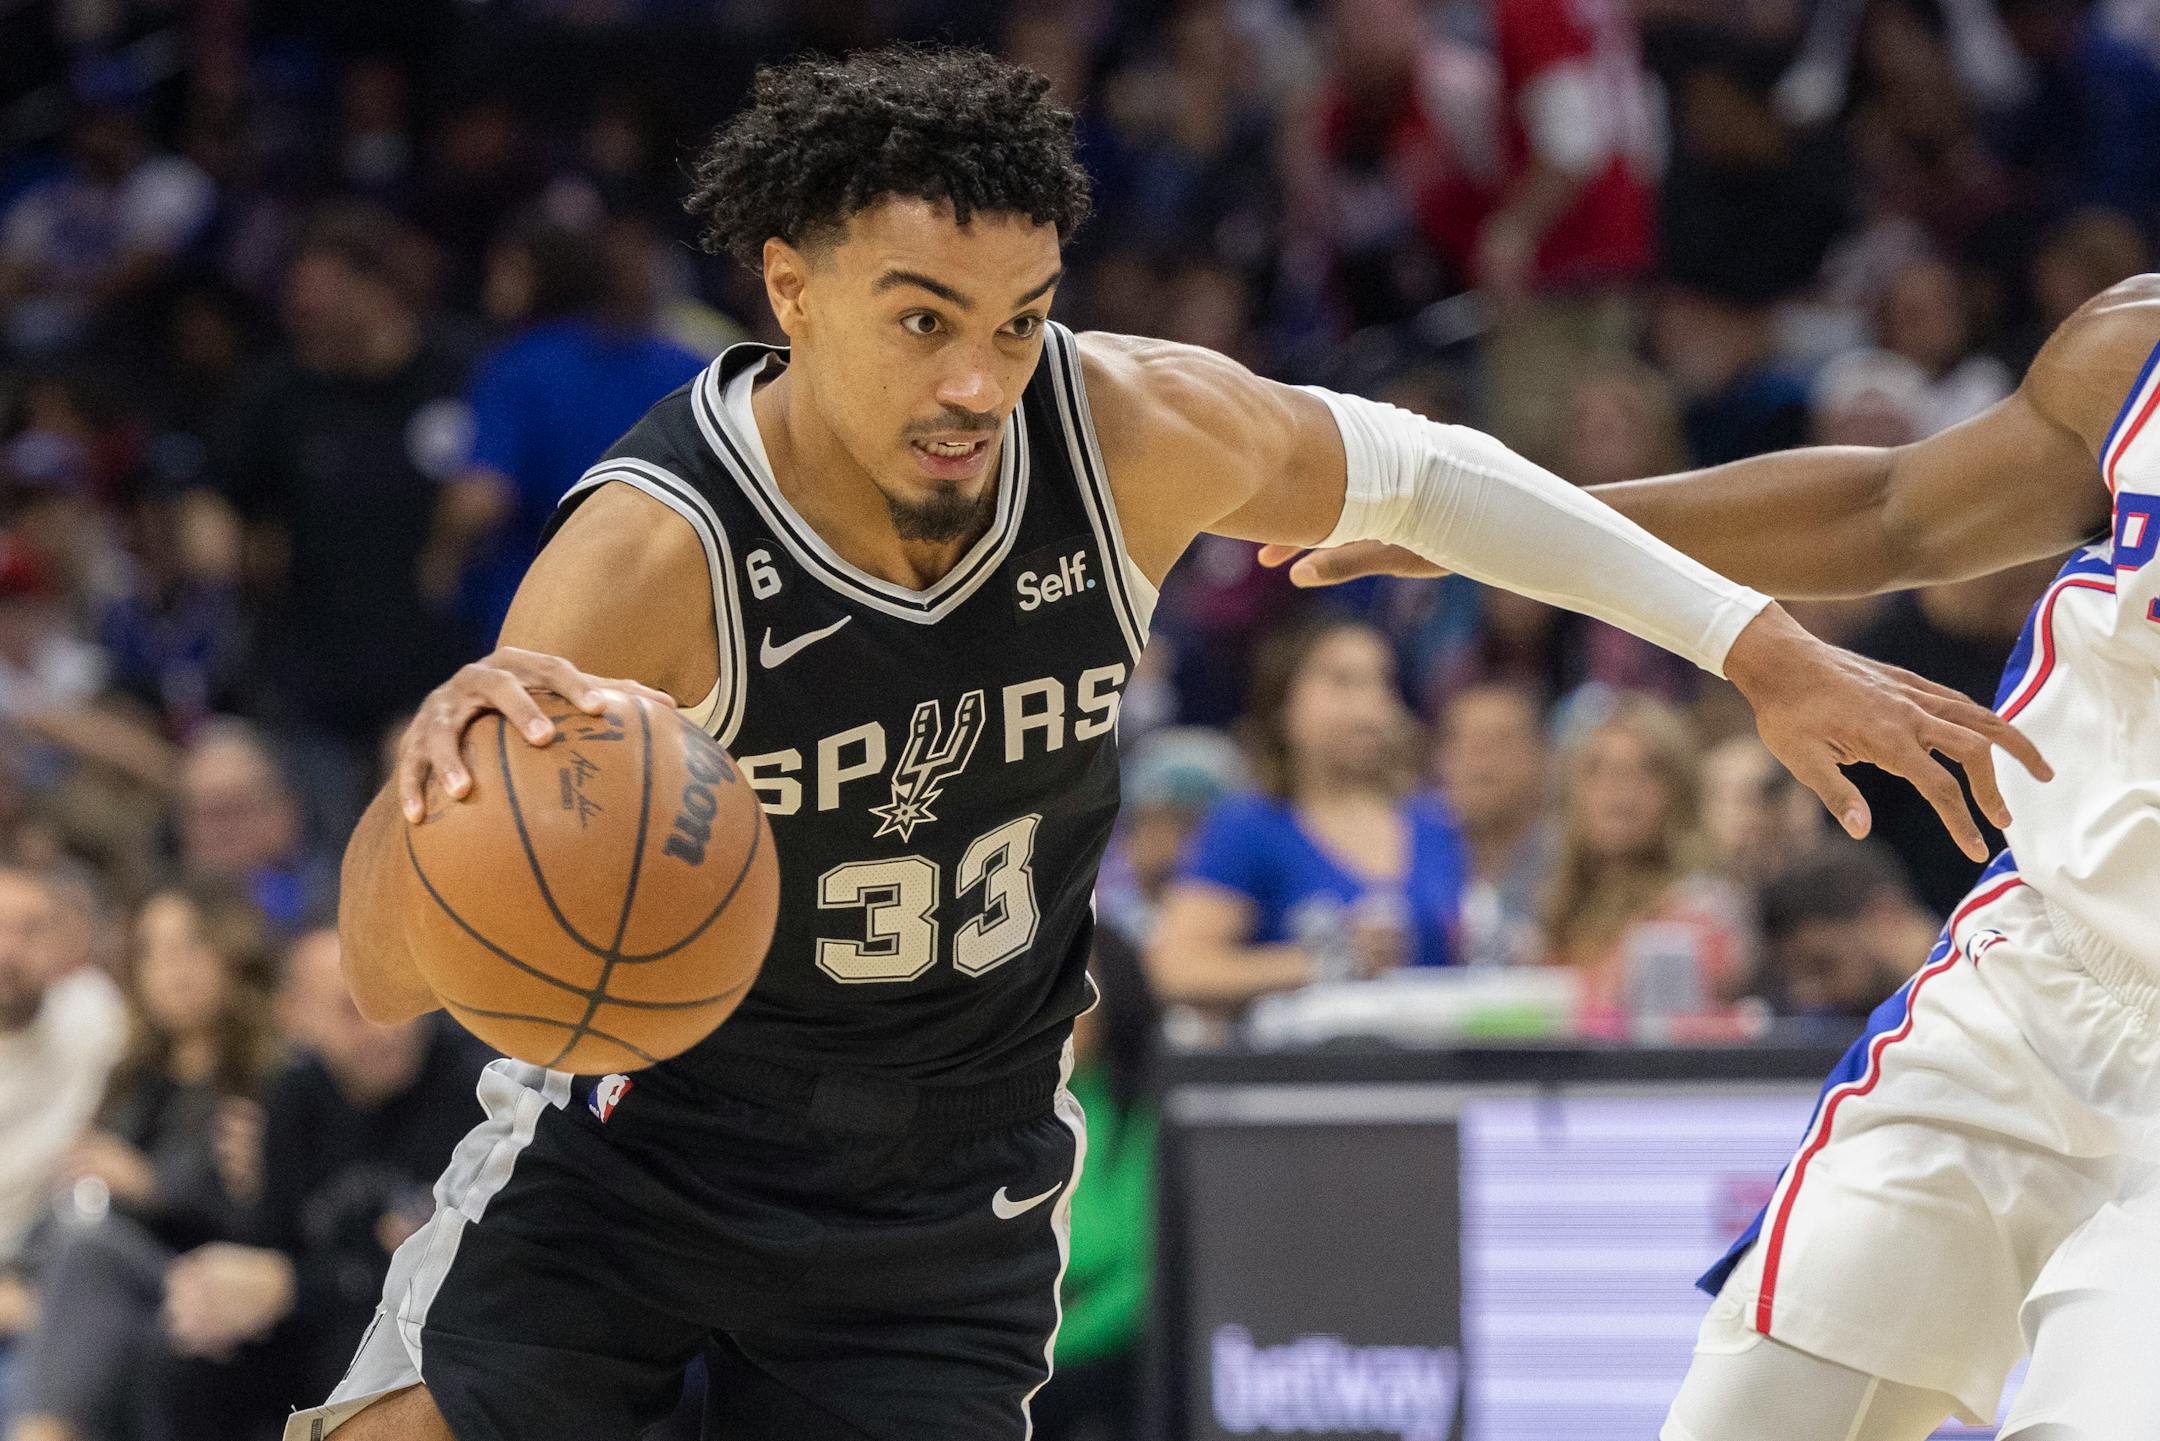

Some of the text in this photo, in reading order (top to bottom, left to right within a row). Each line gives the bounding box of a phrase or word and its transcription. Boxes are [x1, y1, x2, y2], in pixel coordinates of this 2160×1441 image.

[745, 547, 783, 601] 6
[1015, 550, 1097, 611] Self.
[737, 661, 1127, 843] SPURS
[815, 812, 1043, 985] 33
